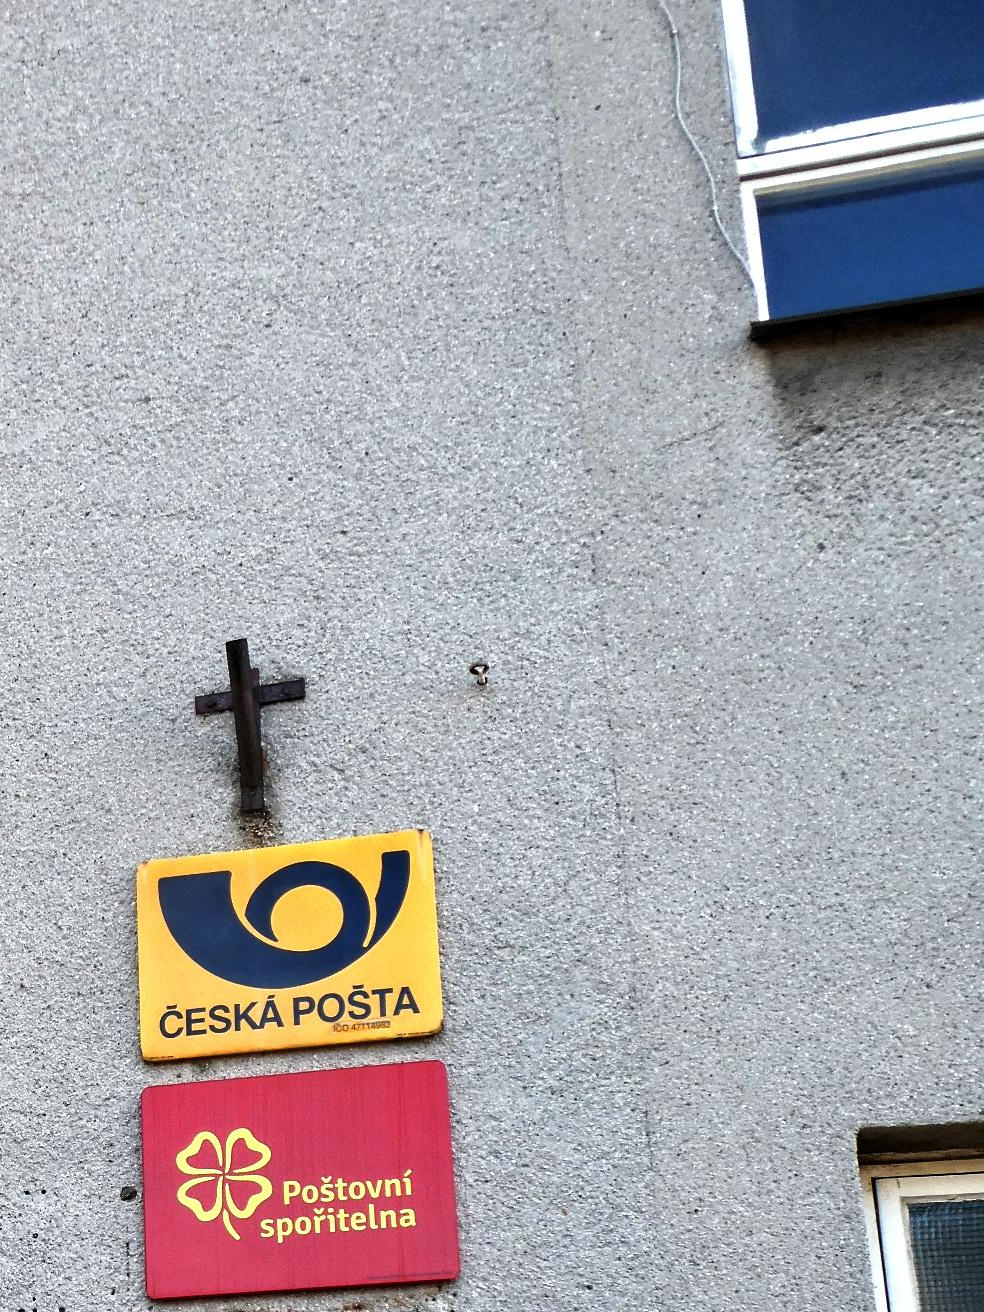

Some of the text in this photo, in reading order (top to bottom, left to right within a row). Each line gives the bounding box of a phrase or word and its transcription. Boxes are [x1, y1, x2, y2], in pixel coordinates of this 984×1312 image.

[159, 985, 421, 1039] ČESKÁ POŠTA
[283, 1169, 413, 1206] Poštovní
[260, 1203, 417, 1244] spořitelna
